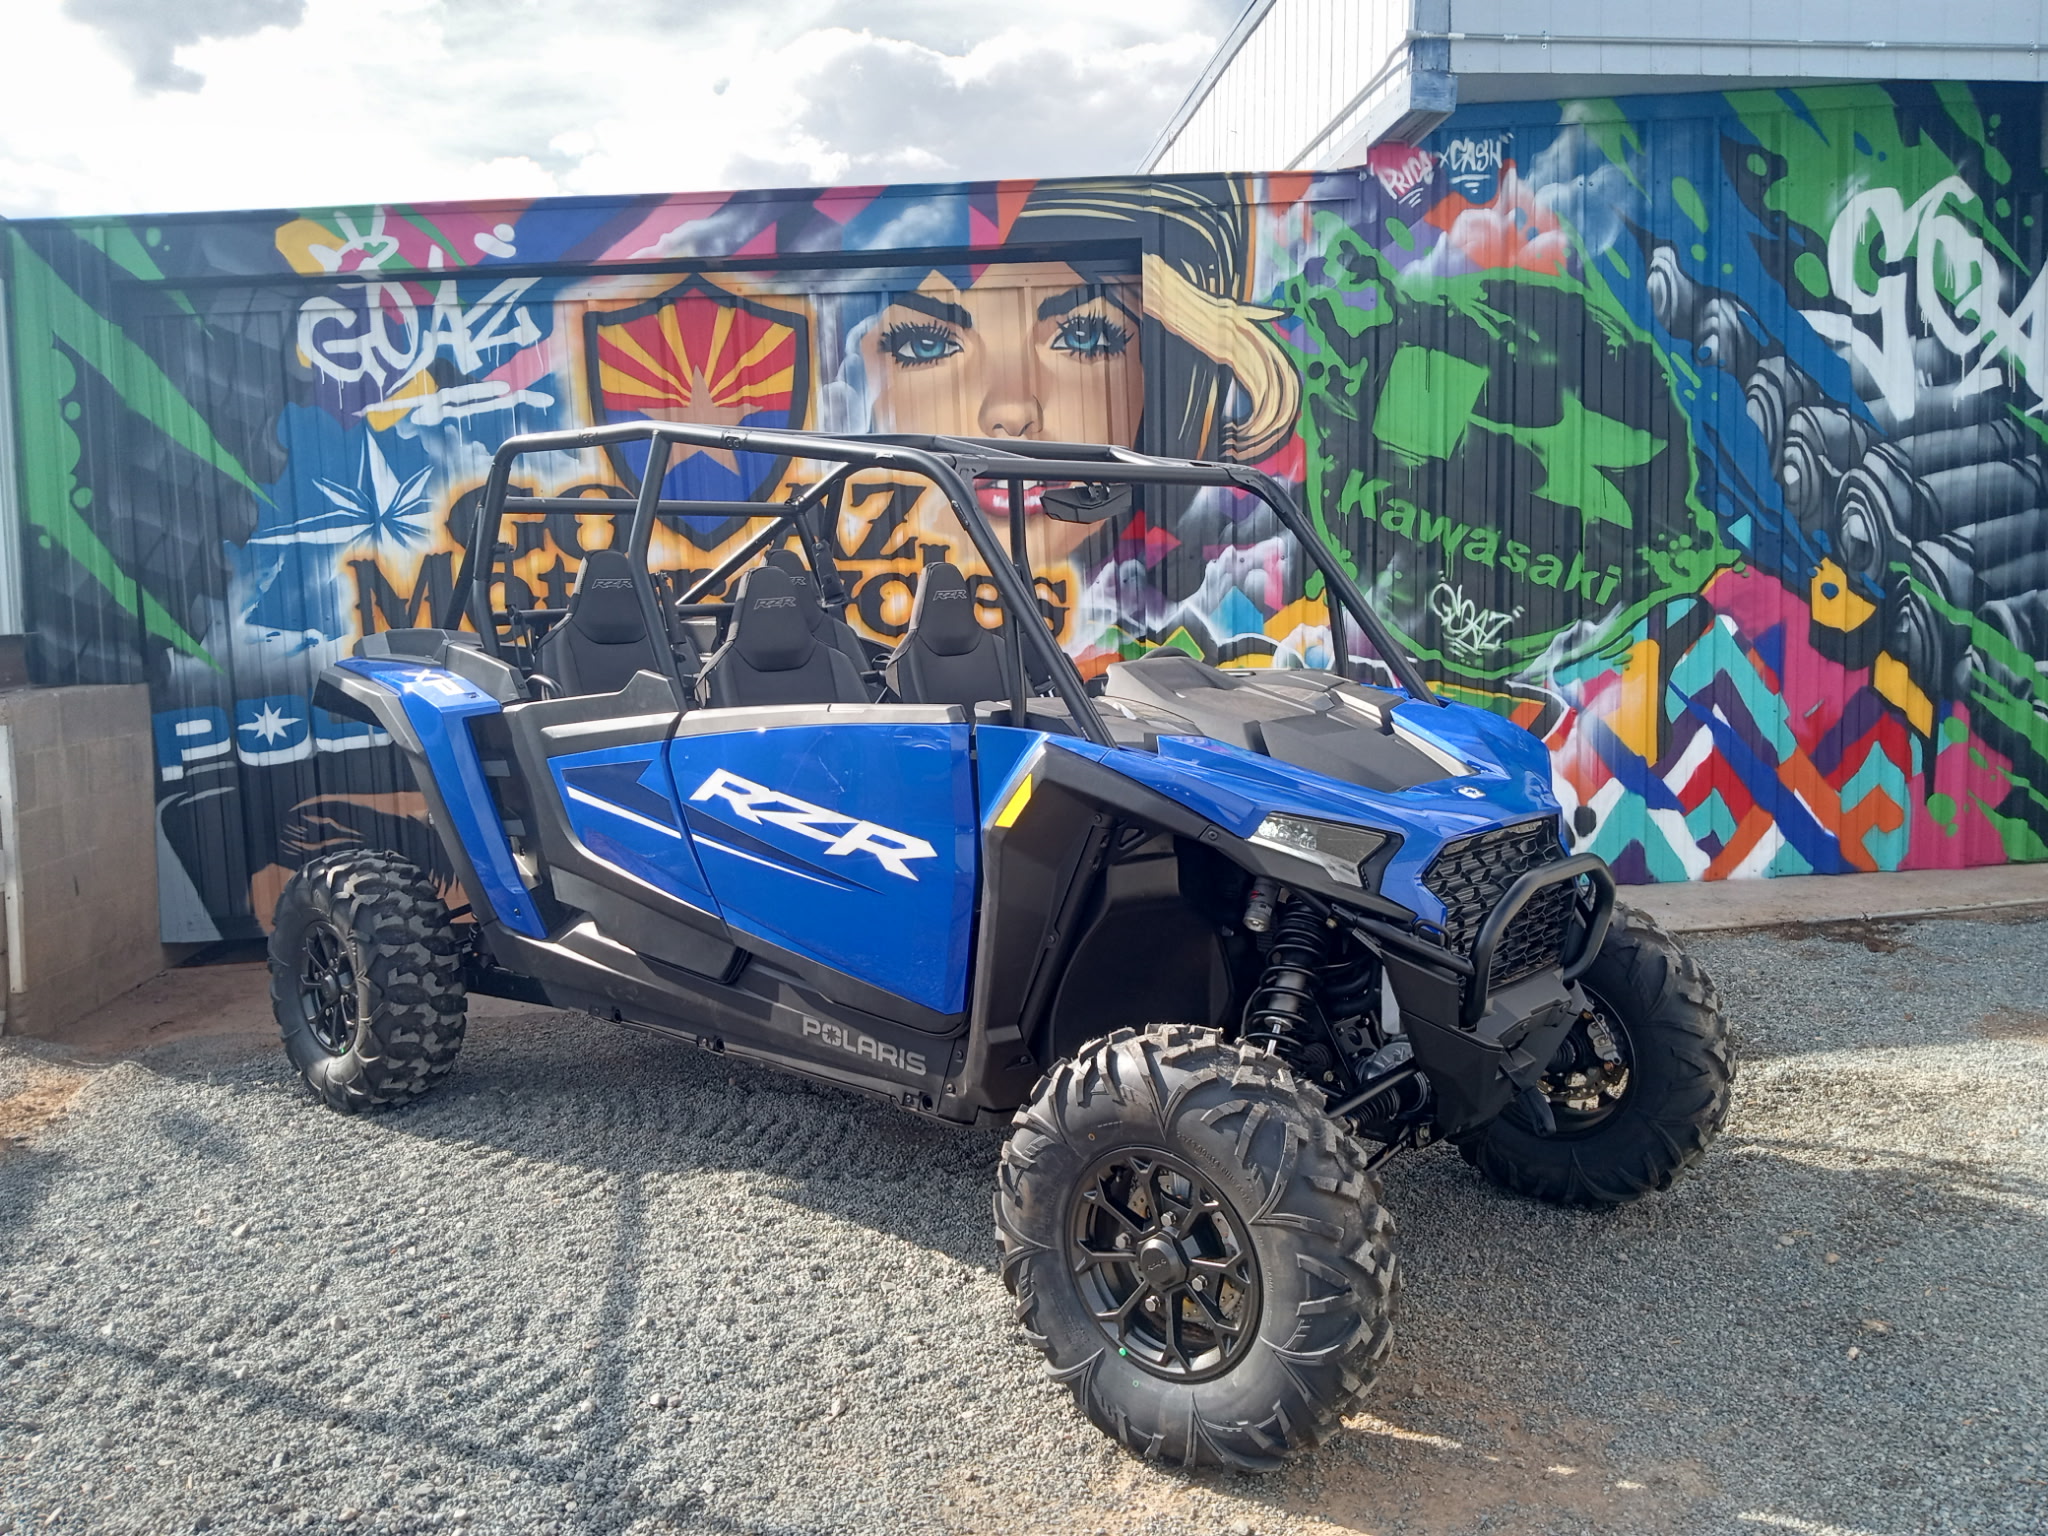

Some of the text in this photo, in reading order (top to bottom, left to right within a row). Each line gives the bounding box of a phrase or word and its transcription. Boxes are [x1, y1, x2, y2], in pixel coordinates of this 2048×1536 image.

[1337, 468, 1622, 606] Kawasaki
[754, 596, 796, 610] RZR
[932, 589, 967, 601] RZR
[401, 668, 466, 696] XP
[689, 768, 938, 882] RZR
[802, 1015, 927, 1077] POLARIS
